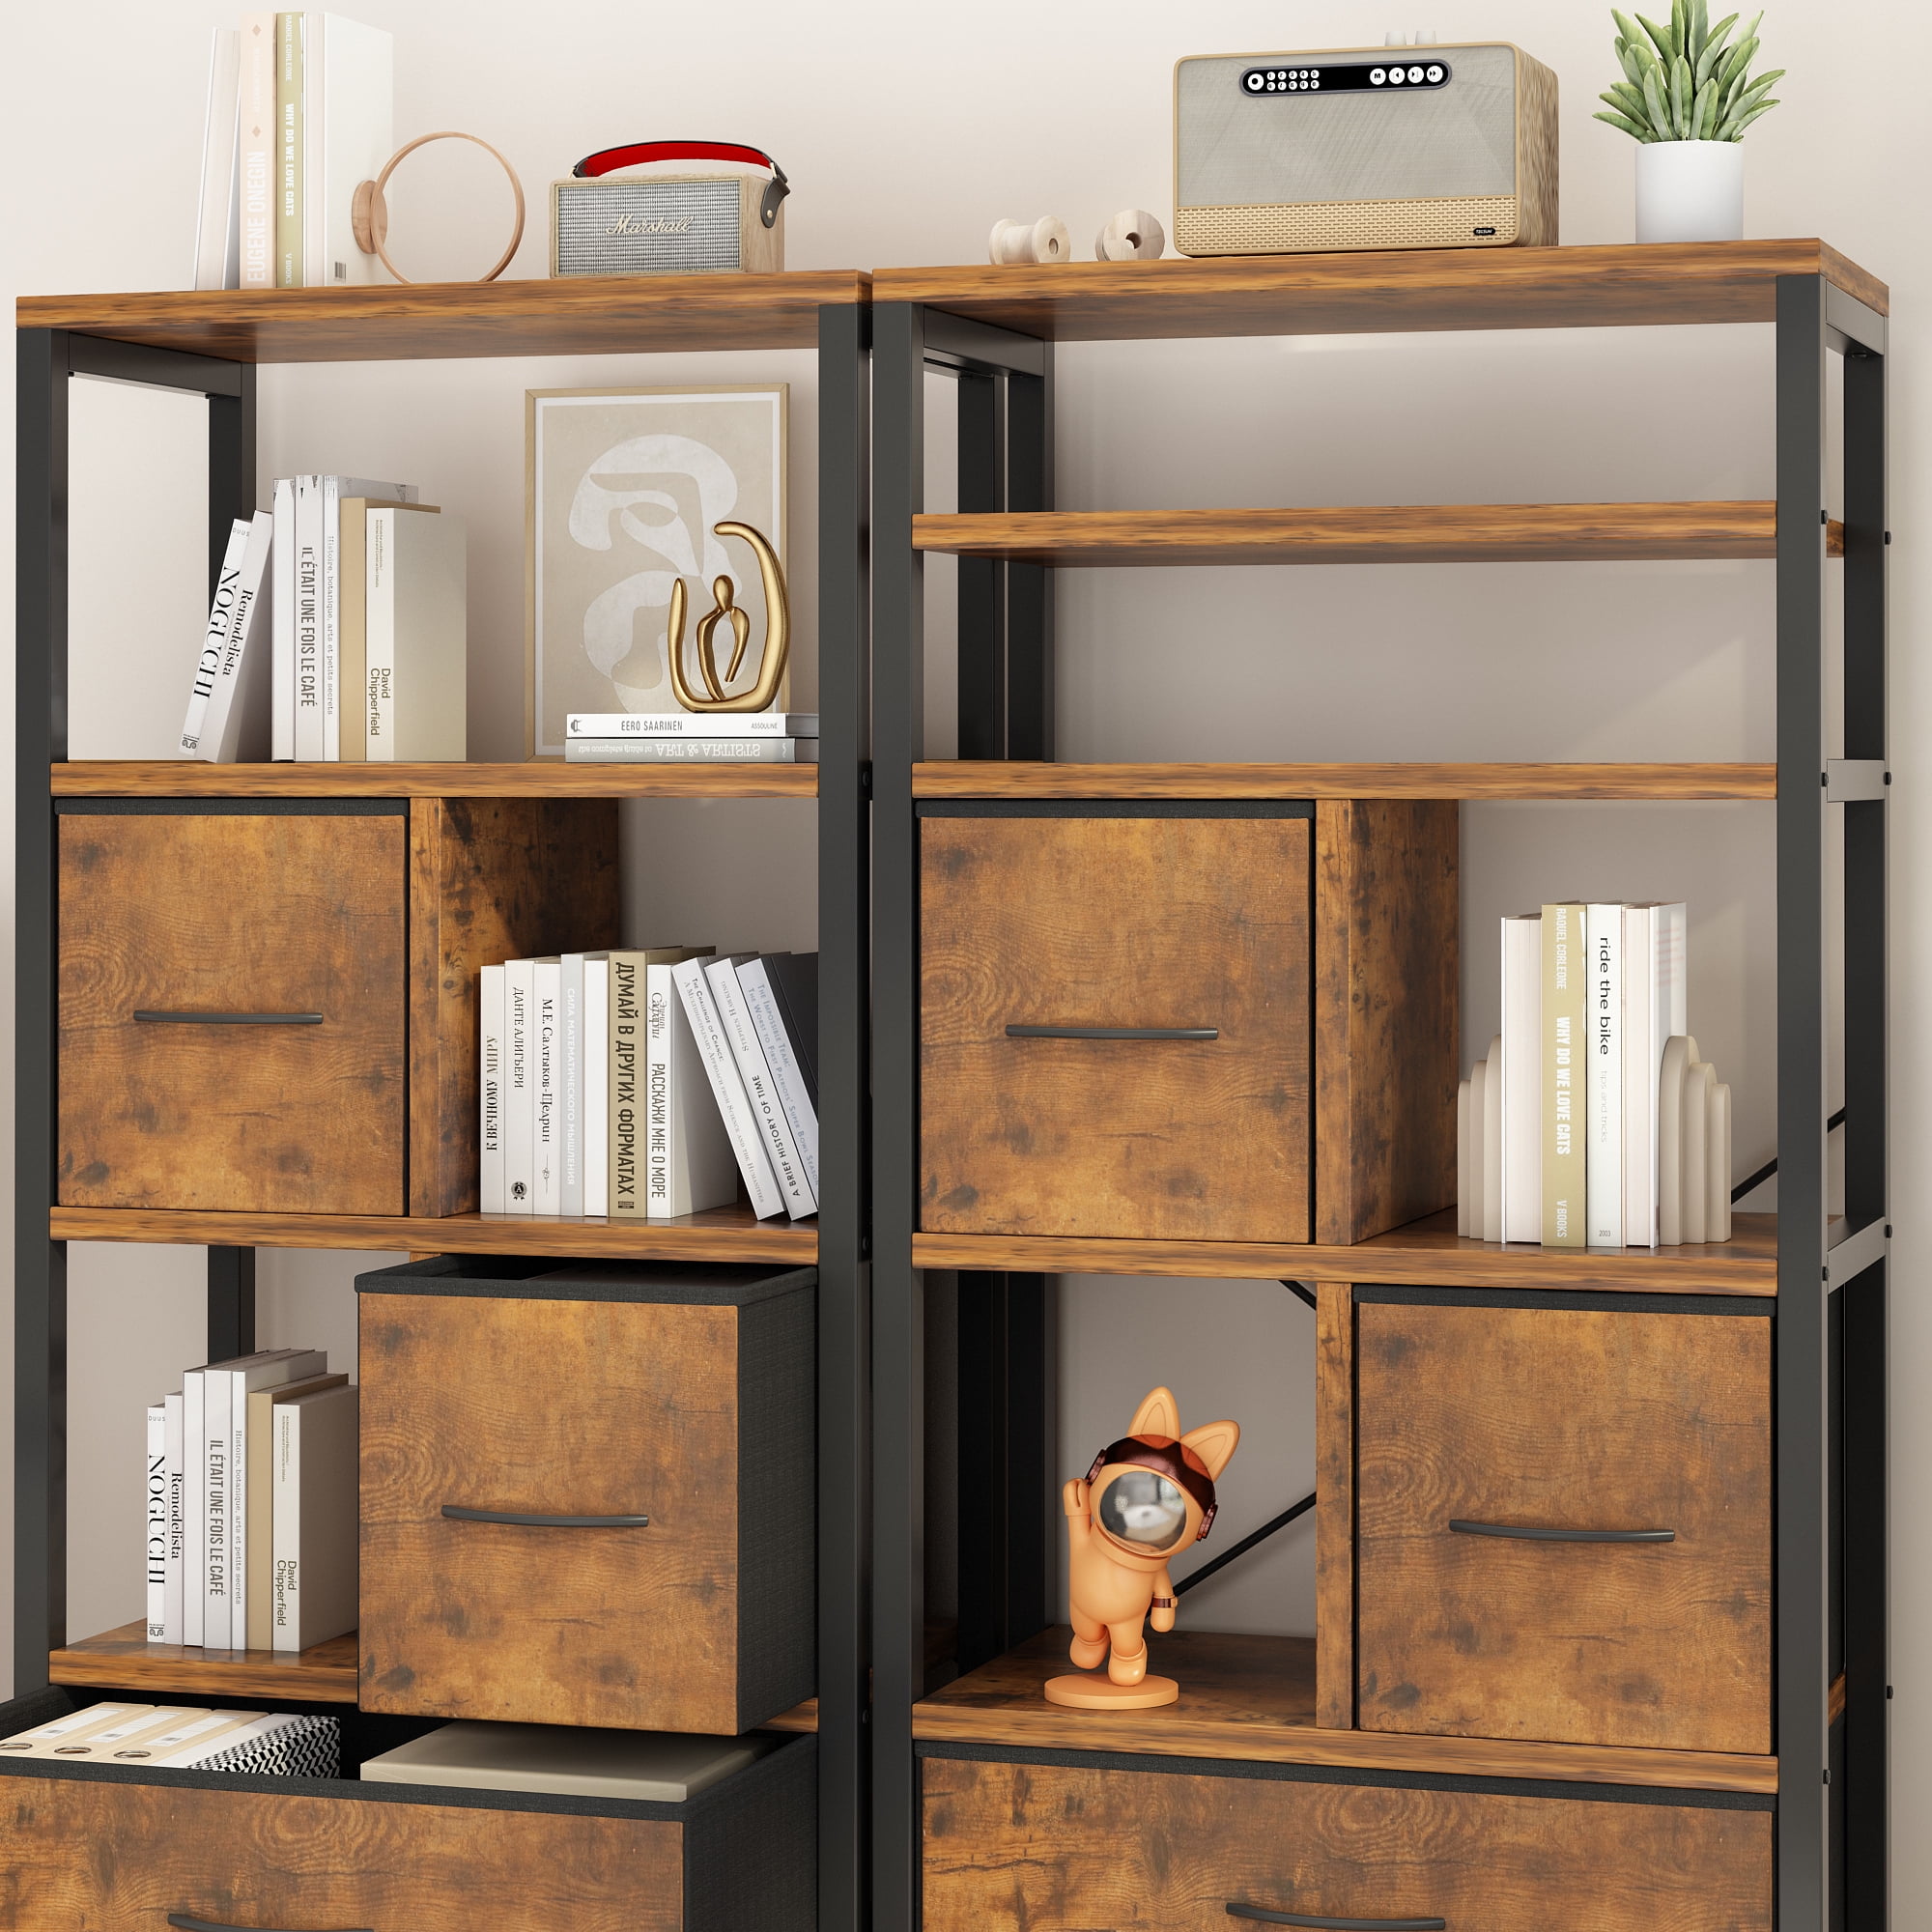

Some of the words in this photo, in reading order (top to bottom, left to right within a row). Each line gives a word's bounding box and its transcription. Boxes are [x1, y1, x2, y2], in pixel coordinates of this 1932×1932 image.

[285, 103, 295, 127] WHY
[285, 128, 295, 142] DO
[285, 145, 295, 160] WE
[247, 151, 266, 213] ONEGIN
[285, 163, 295, 187] LOVE
[285, 190, 295, 216] CATS
[606, 214, 694, 235] Marshall
[247, 217, 266, 282] EUGENE
[301, 559, 317, 596] ÉTAIT
[301, 599, 316, 624] UNE
[193, 566, 241, 698] NOGUCHI
[222, 589, 253, 676] Remodelista
[301, 628, 316, 654] FOIS
[301, 658, 316, 672] LE
[301, 675, 318, 707] CAFÉ
[381, 668, 391, 699] David
[368, 668, 381, 736] Chipperfield
[620, 720, 641, 731] EERO
[643, 720, 683, 731] SAARINEN
[1556, 908, 1567, 943] RAQUEL
[1556, 944, 1567, 990] CORLEONE
[1600, 937, 1611, 974] ride
[567, 988, 576, 1016] СИЛА
[614, 961, 639, 1019] ДУМАЙ
[1600, 979, 1611, 1009] the
[512, 986, 525, 1026] ДАНТЕ
[617, 1025, 636, 1036] В
[1556, 1016, 1571, 1044] WHY
[1600, 1016, 1611, 1056] bike
[486, 1035, 498, 1074] МИРУ
[513, 1027, 525, 1089] АЛИГЬЕРИ
[1556, 1047, 1571, 1065] DO
[614, 1039, 636, 1103] ДРУГИХ
[752, 1074, 766, 1099] TIME
[1556, 1067, 1571, 1089] WE
[651, 1063, 666, 1124] РАССКАЖИ
[760, 1101, 771, 1115] OF
[1556, 1091, 1571, 1121] LOVE
[486, 1079, 498, 1140] ВЕЧНОМУ
[617, 1108, 636, 1195] ФОРМАТАХ
[651, 1127, 666, 1153] МНЕ
[766, 1118, 787, 1158] HISTORY
[1556, 1123, 1571, 1154] CATS
[651, 1155, 666, 1164] О
[781, 1160, 797, 1187] BRIEF
[651, 1166, 666, 1199] МОРЕ
[792, 1188, 801, 1197] A
[1556, 1209, 1567, 1237] BOOKS
[210, 1439, 224, 1451] IL
[210, 1454, 227, 1489] ÉTAIT
[148, 1454, 165, 1584] NOGUCHI
[171, 1471, 184, 1560] Remodelista
[210, 1491, 224, 1516] UNE
[210, 1519, 224, 1545] FOIS
[210, 1548, 224, 1563] LE
[209, 1565, 227, 1597] CAFÉ
[287, 1560, 298, 1591] David
[275, 1559, 288, 1627] Chipperfield
